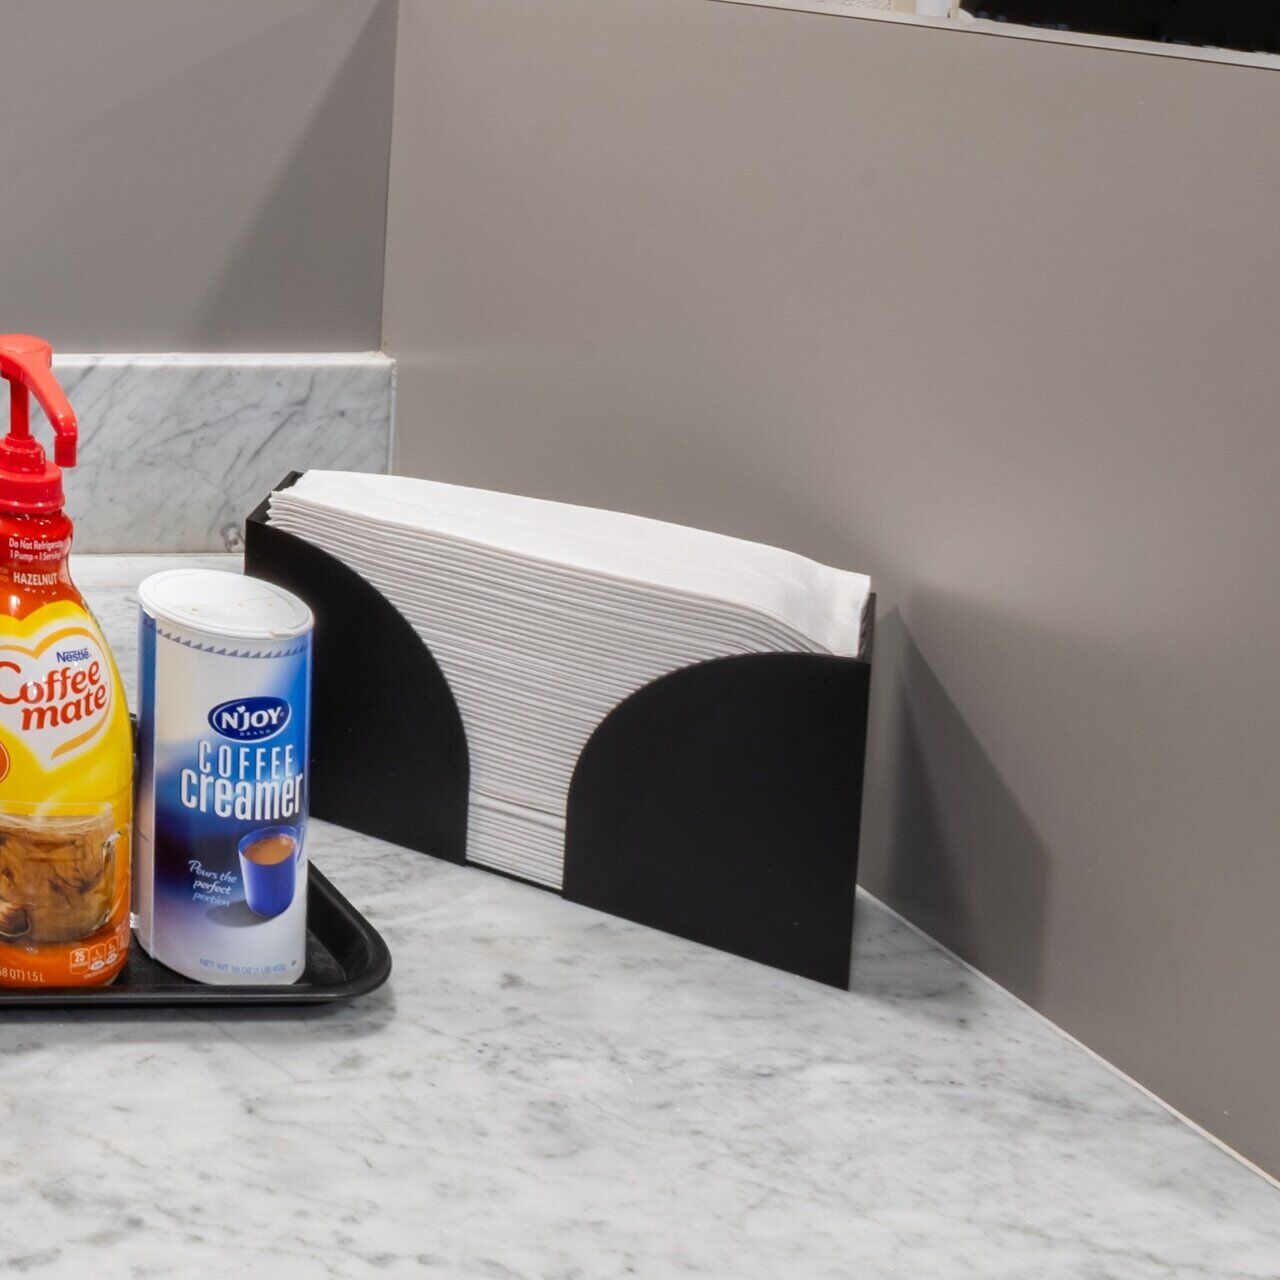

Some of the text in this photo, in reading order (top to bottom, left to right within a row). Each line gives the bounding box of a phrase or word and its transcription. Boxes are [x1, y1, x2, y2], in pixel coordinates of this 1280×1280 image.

[8, 537, 19, 548] Do
[20, 539, 33, 550] Not
[14, 550, 33, 562] Pump
[13, 572, 58, 586] HAZELNUT
[56, 648, 91, 662] Nestlé
[21, 684, 107, 731] mate
[240, 728, 272, 736] BRAND
[199, 739, 293, 780] COFFEE
[181, 768, 303, 820] creamer
[188, 860, 237, 883] Pours the
[193, 880, 232, 895] perfect
[192, 892, 231, 907] portion
[74, 950, 85, 962] 25
[200, 959, 214, 969] NET
[216, 963, 229, 971] WT
[241, 965, 252, 974] OZ
[9, 967, 25, 982] QT)
